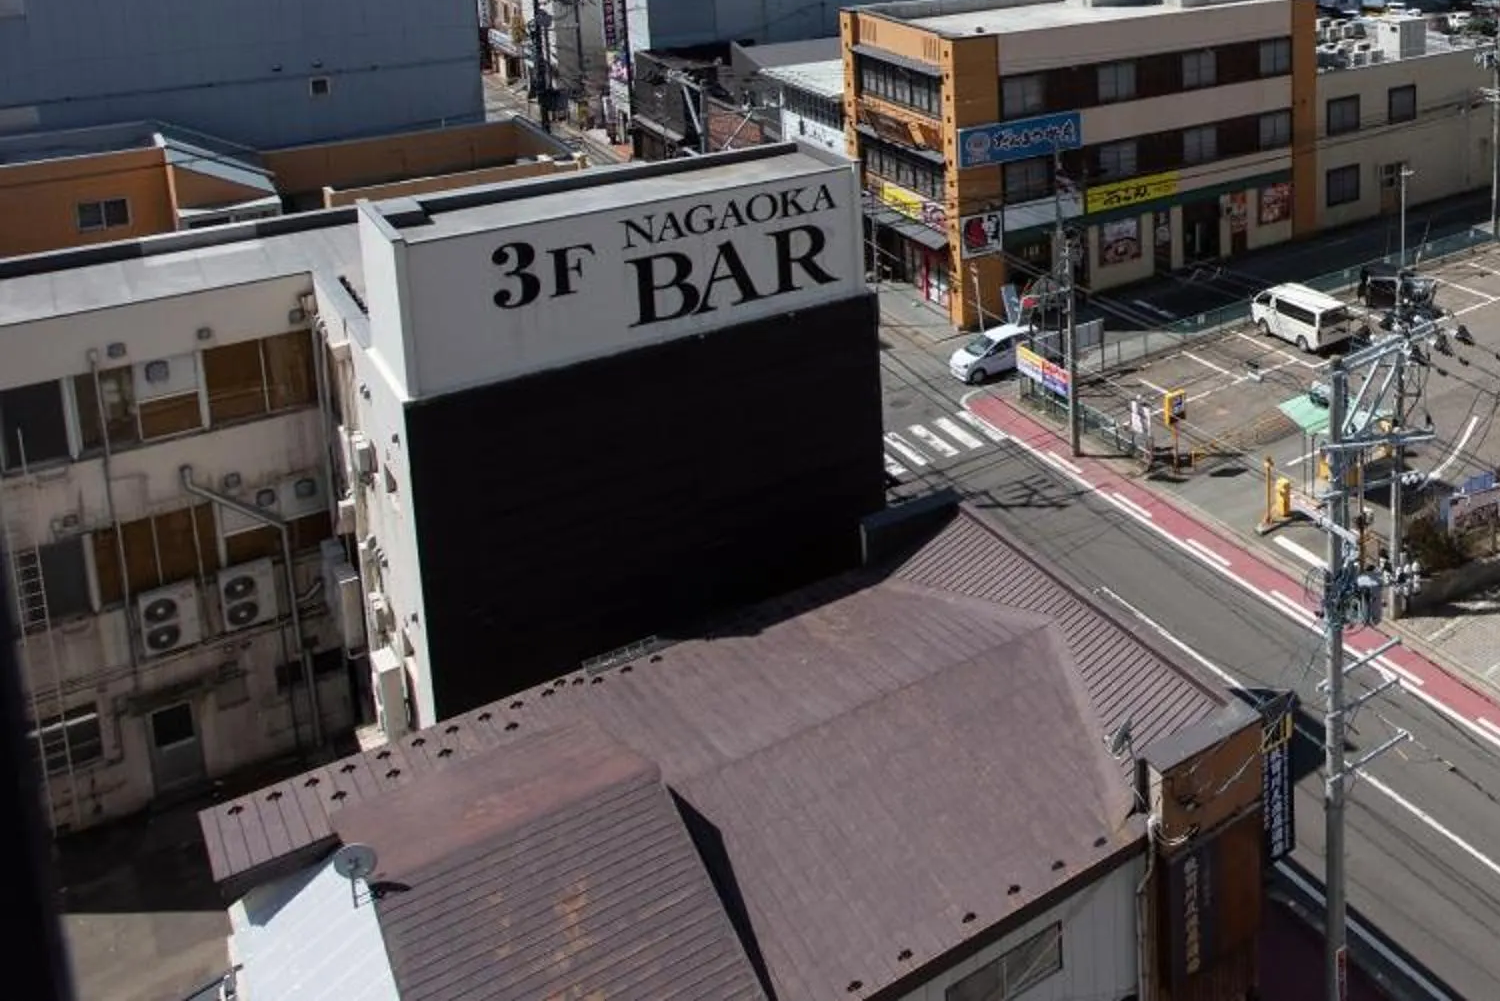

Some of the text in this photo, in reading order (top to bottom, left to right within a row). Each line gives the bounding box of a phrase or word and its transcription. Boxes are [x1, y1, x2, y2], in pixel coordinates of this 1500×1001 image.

[619, 183, 837, 250] NAGAOKA
[490, 241, 596, 311] 3F
[623, 223, 842, 329] BAR
